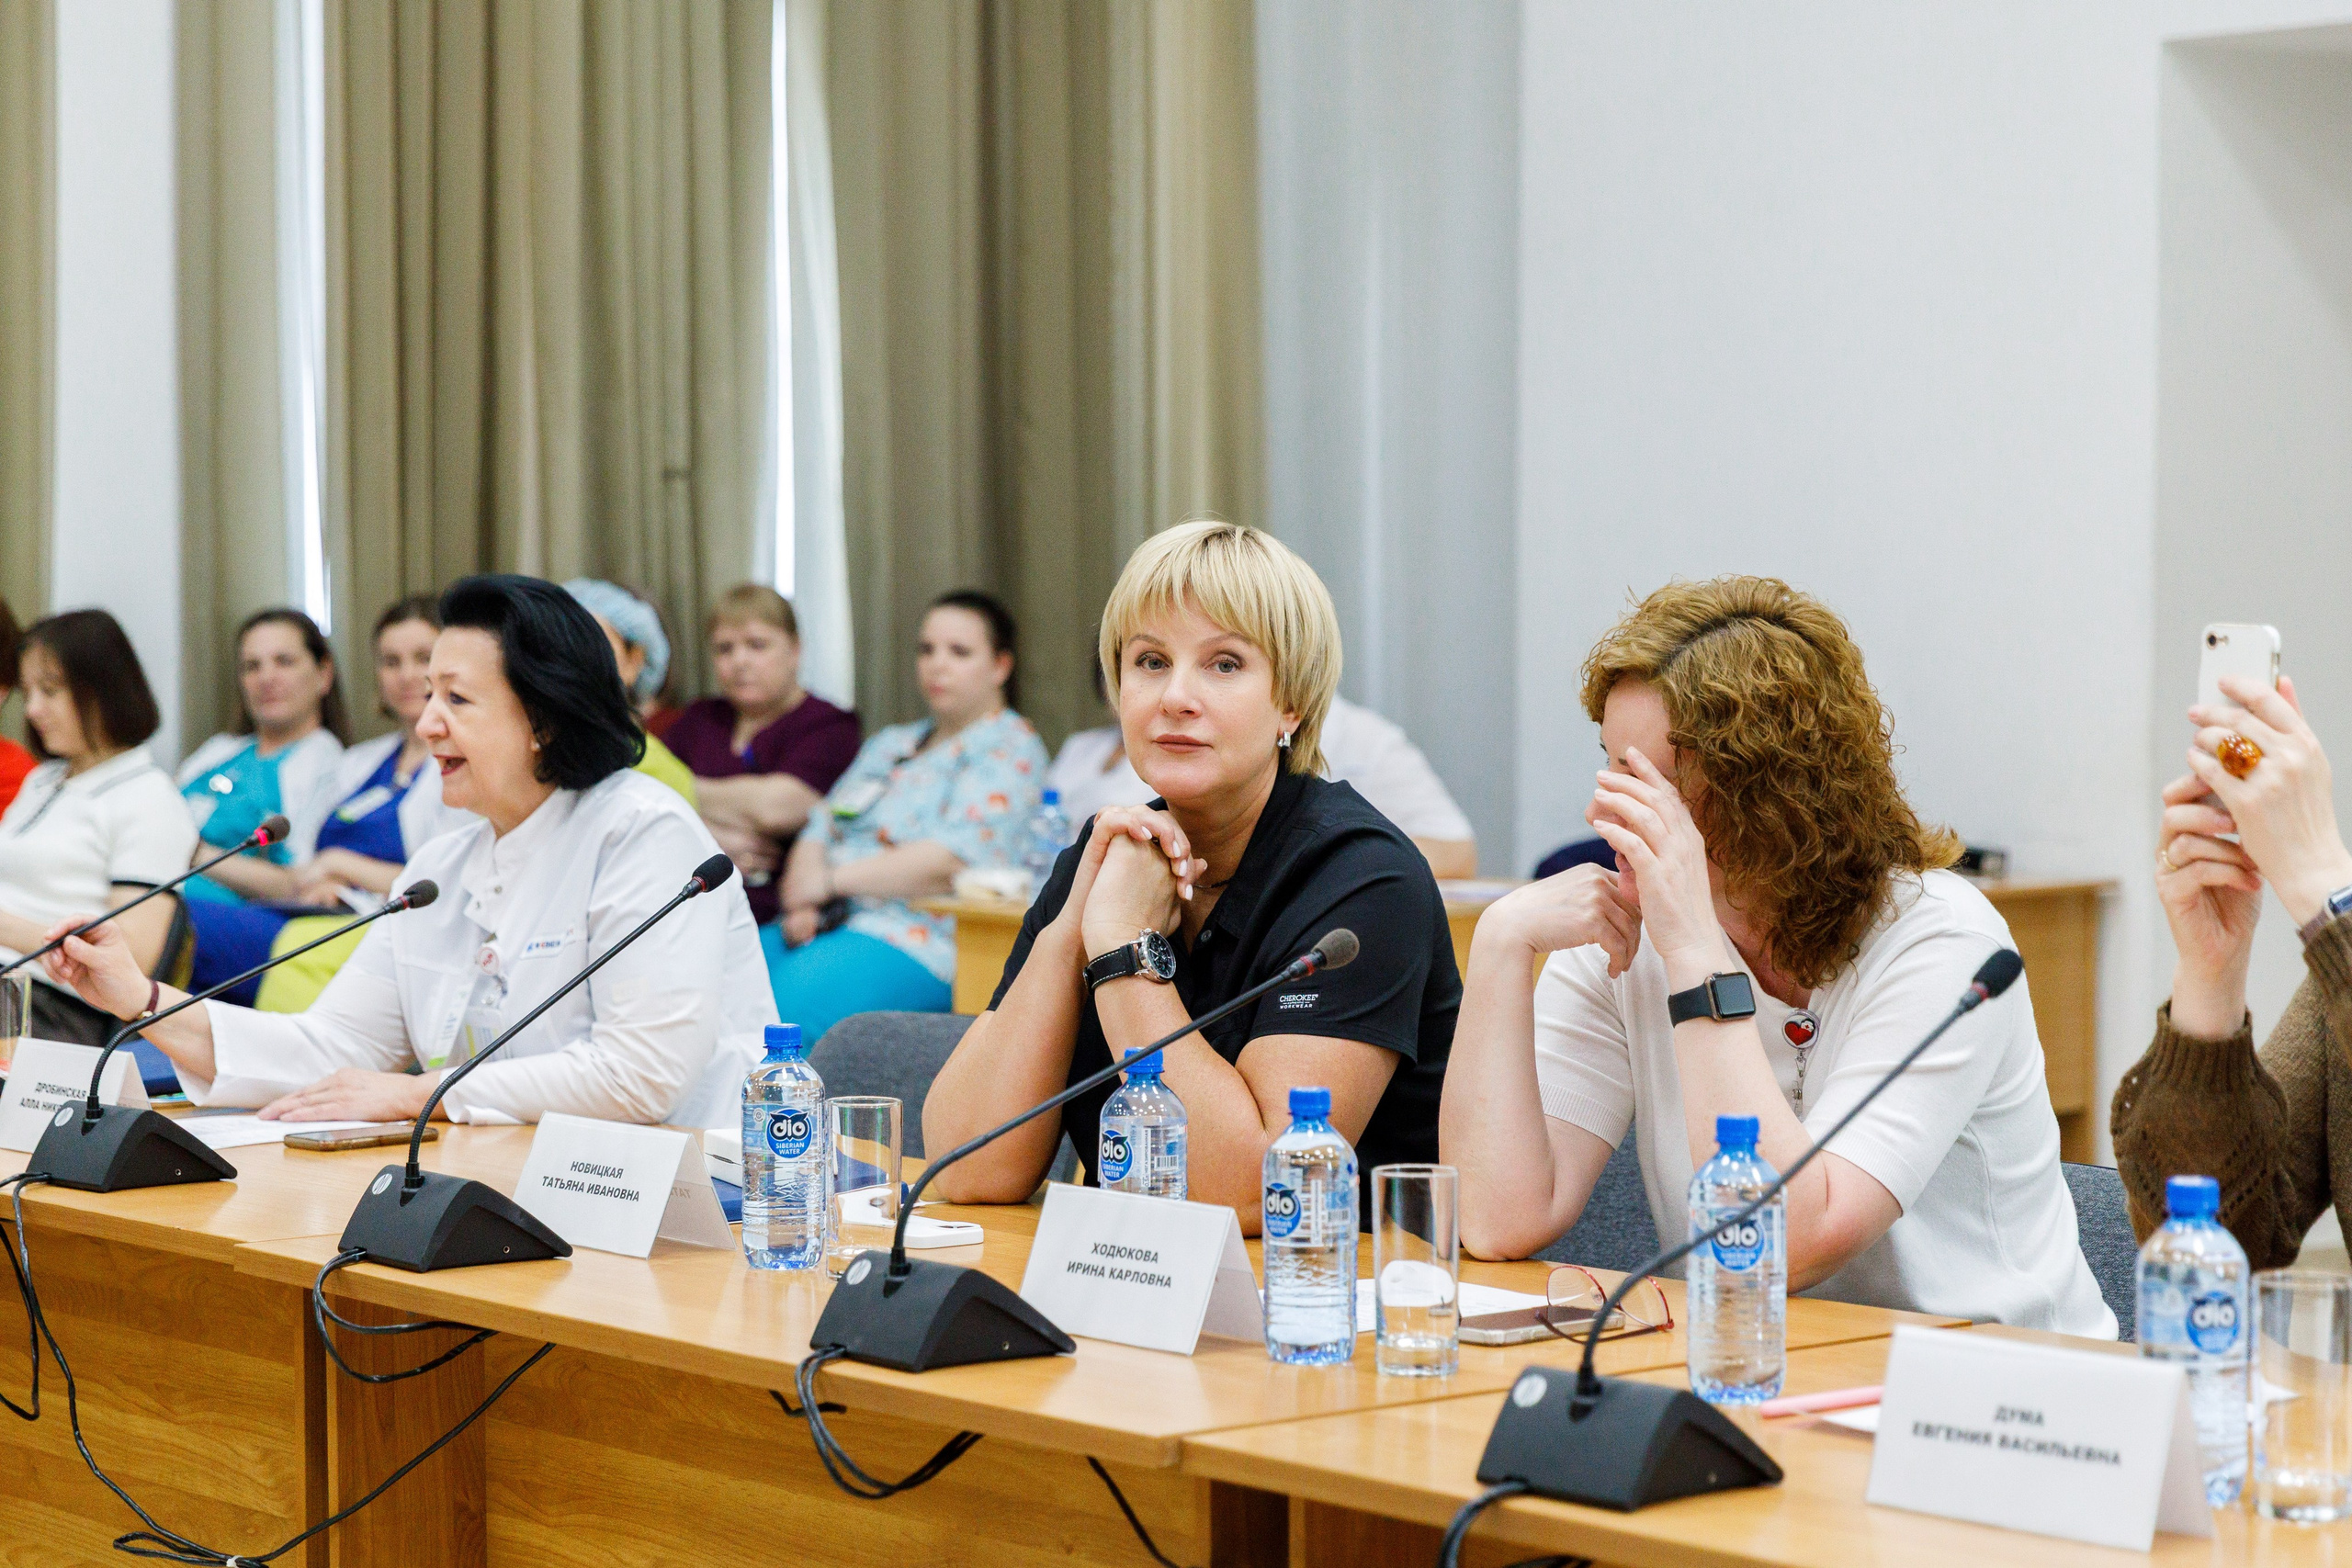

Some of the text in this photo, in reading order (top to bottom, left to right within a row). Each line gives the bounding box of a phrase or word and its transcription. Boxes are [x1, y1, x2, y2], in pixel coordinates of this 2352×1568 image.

[35, 1082, 86, 1100] ДРОБИНСКАЯ
[20, 1097, 40, 1109] АЛЛА
[773, 1119, 806, 1137] dio
[1102, 1140, 1125, 1160] dio
[570, 1160, 624, 1179] НОВИЦКАЯ
[1104, 1170, 1120, 1179] WATER
[542, 1176, 639, 1202] ТАТЬЯНА ИВАНОВНА
[1091, 1242, 1159, 1264] ХОДЮКОВА
[1067, 1260, 1171, 1288] ИРИНА КАРЛОВНА
[1995, 1404, 2044, 1426] ДУМА
[1912, 1420, 2121, 1466] ЕВГЕНИЯ ВАСИЛЬЕВНА
